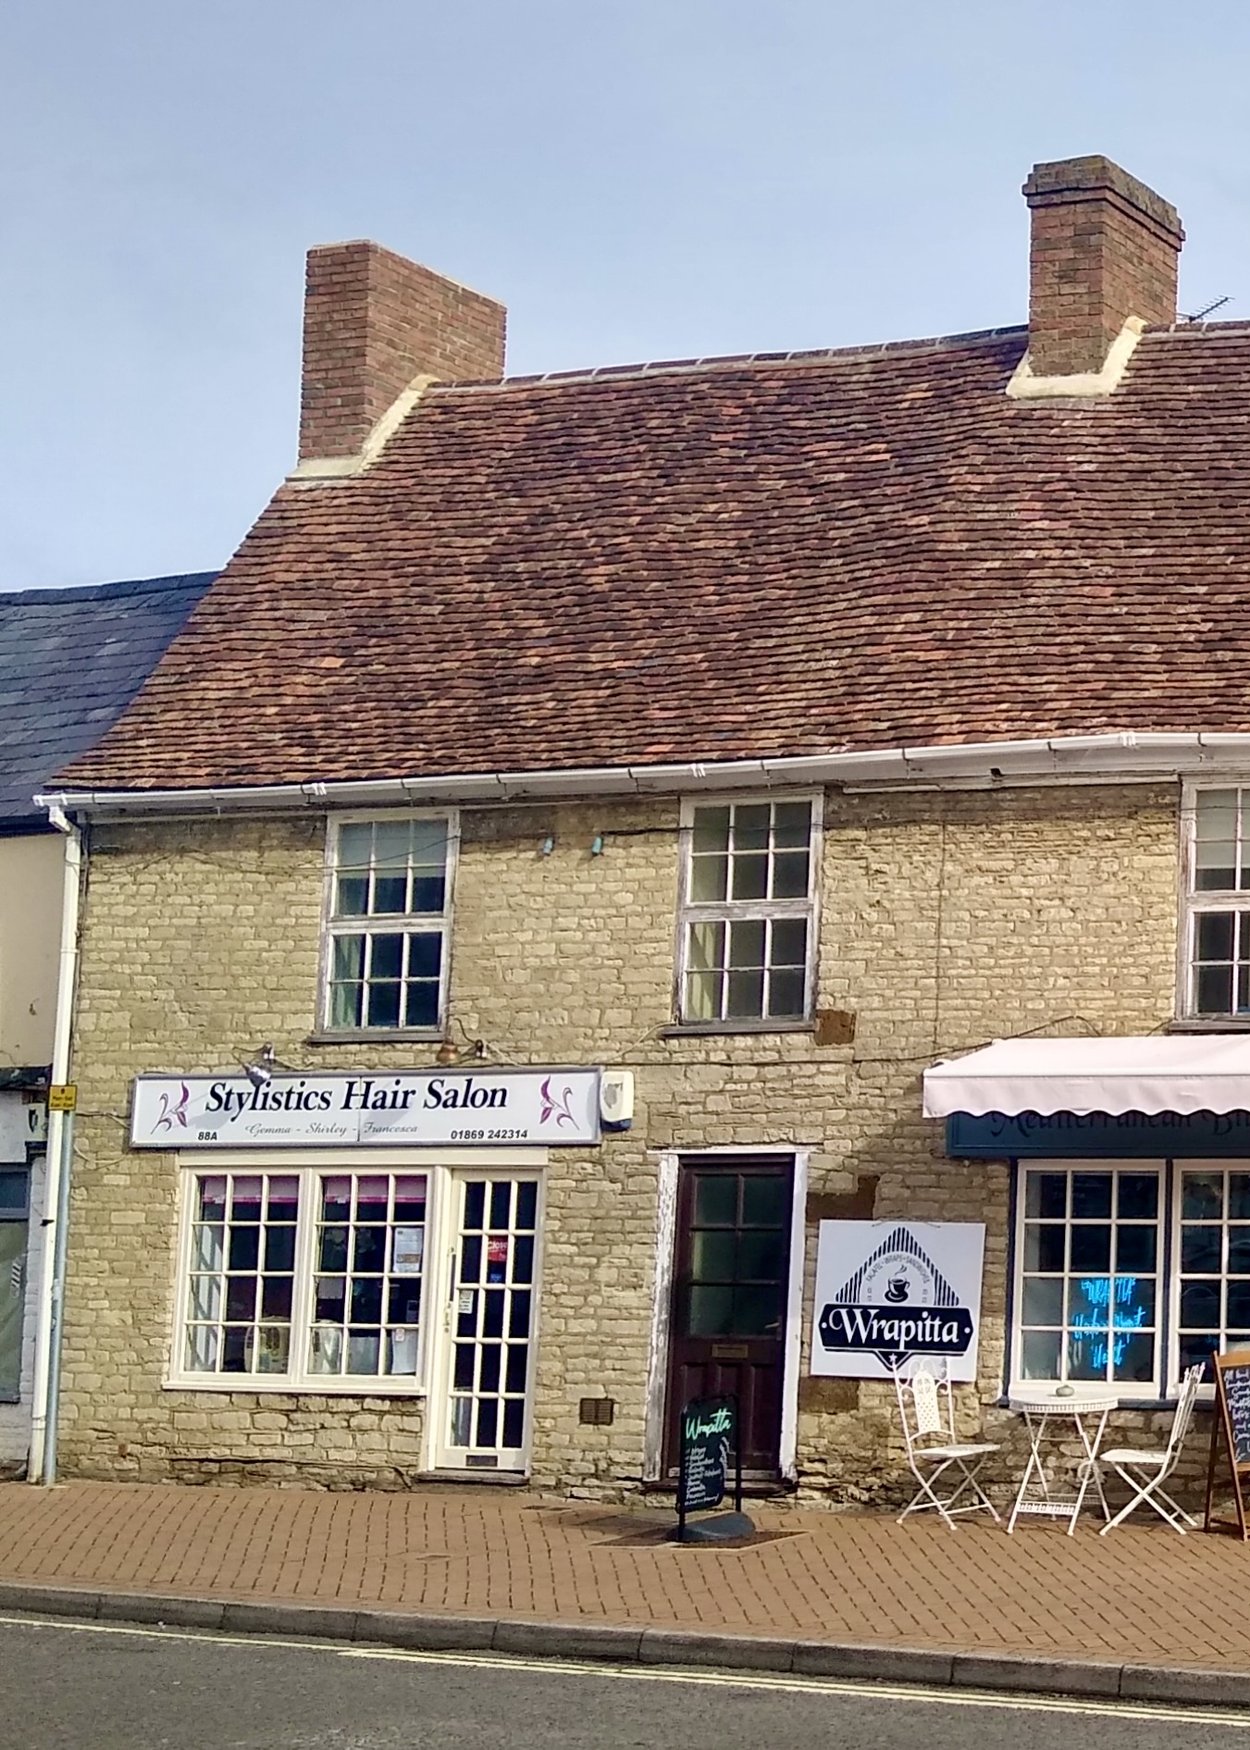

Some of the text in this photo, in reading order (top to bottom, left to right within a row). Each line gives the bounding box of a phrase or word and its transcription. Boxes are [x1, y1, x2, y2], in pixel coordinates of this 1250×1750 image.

[205, 1077, 508, 1122] Stylistics Hair Salon
[245, 1121, 418, 1135] Gemma Shirley Francesca
[450, 1128, 528, 1140] 01869 242314
[198, 1131, 217, 1141] 88A
[829, 1307, 960, 1351] Wrapitta
